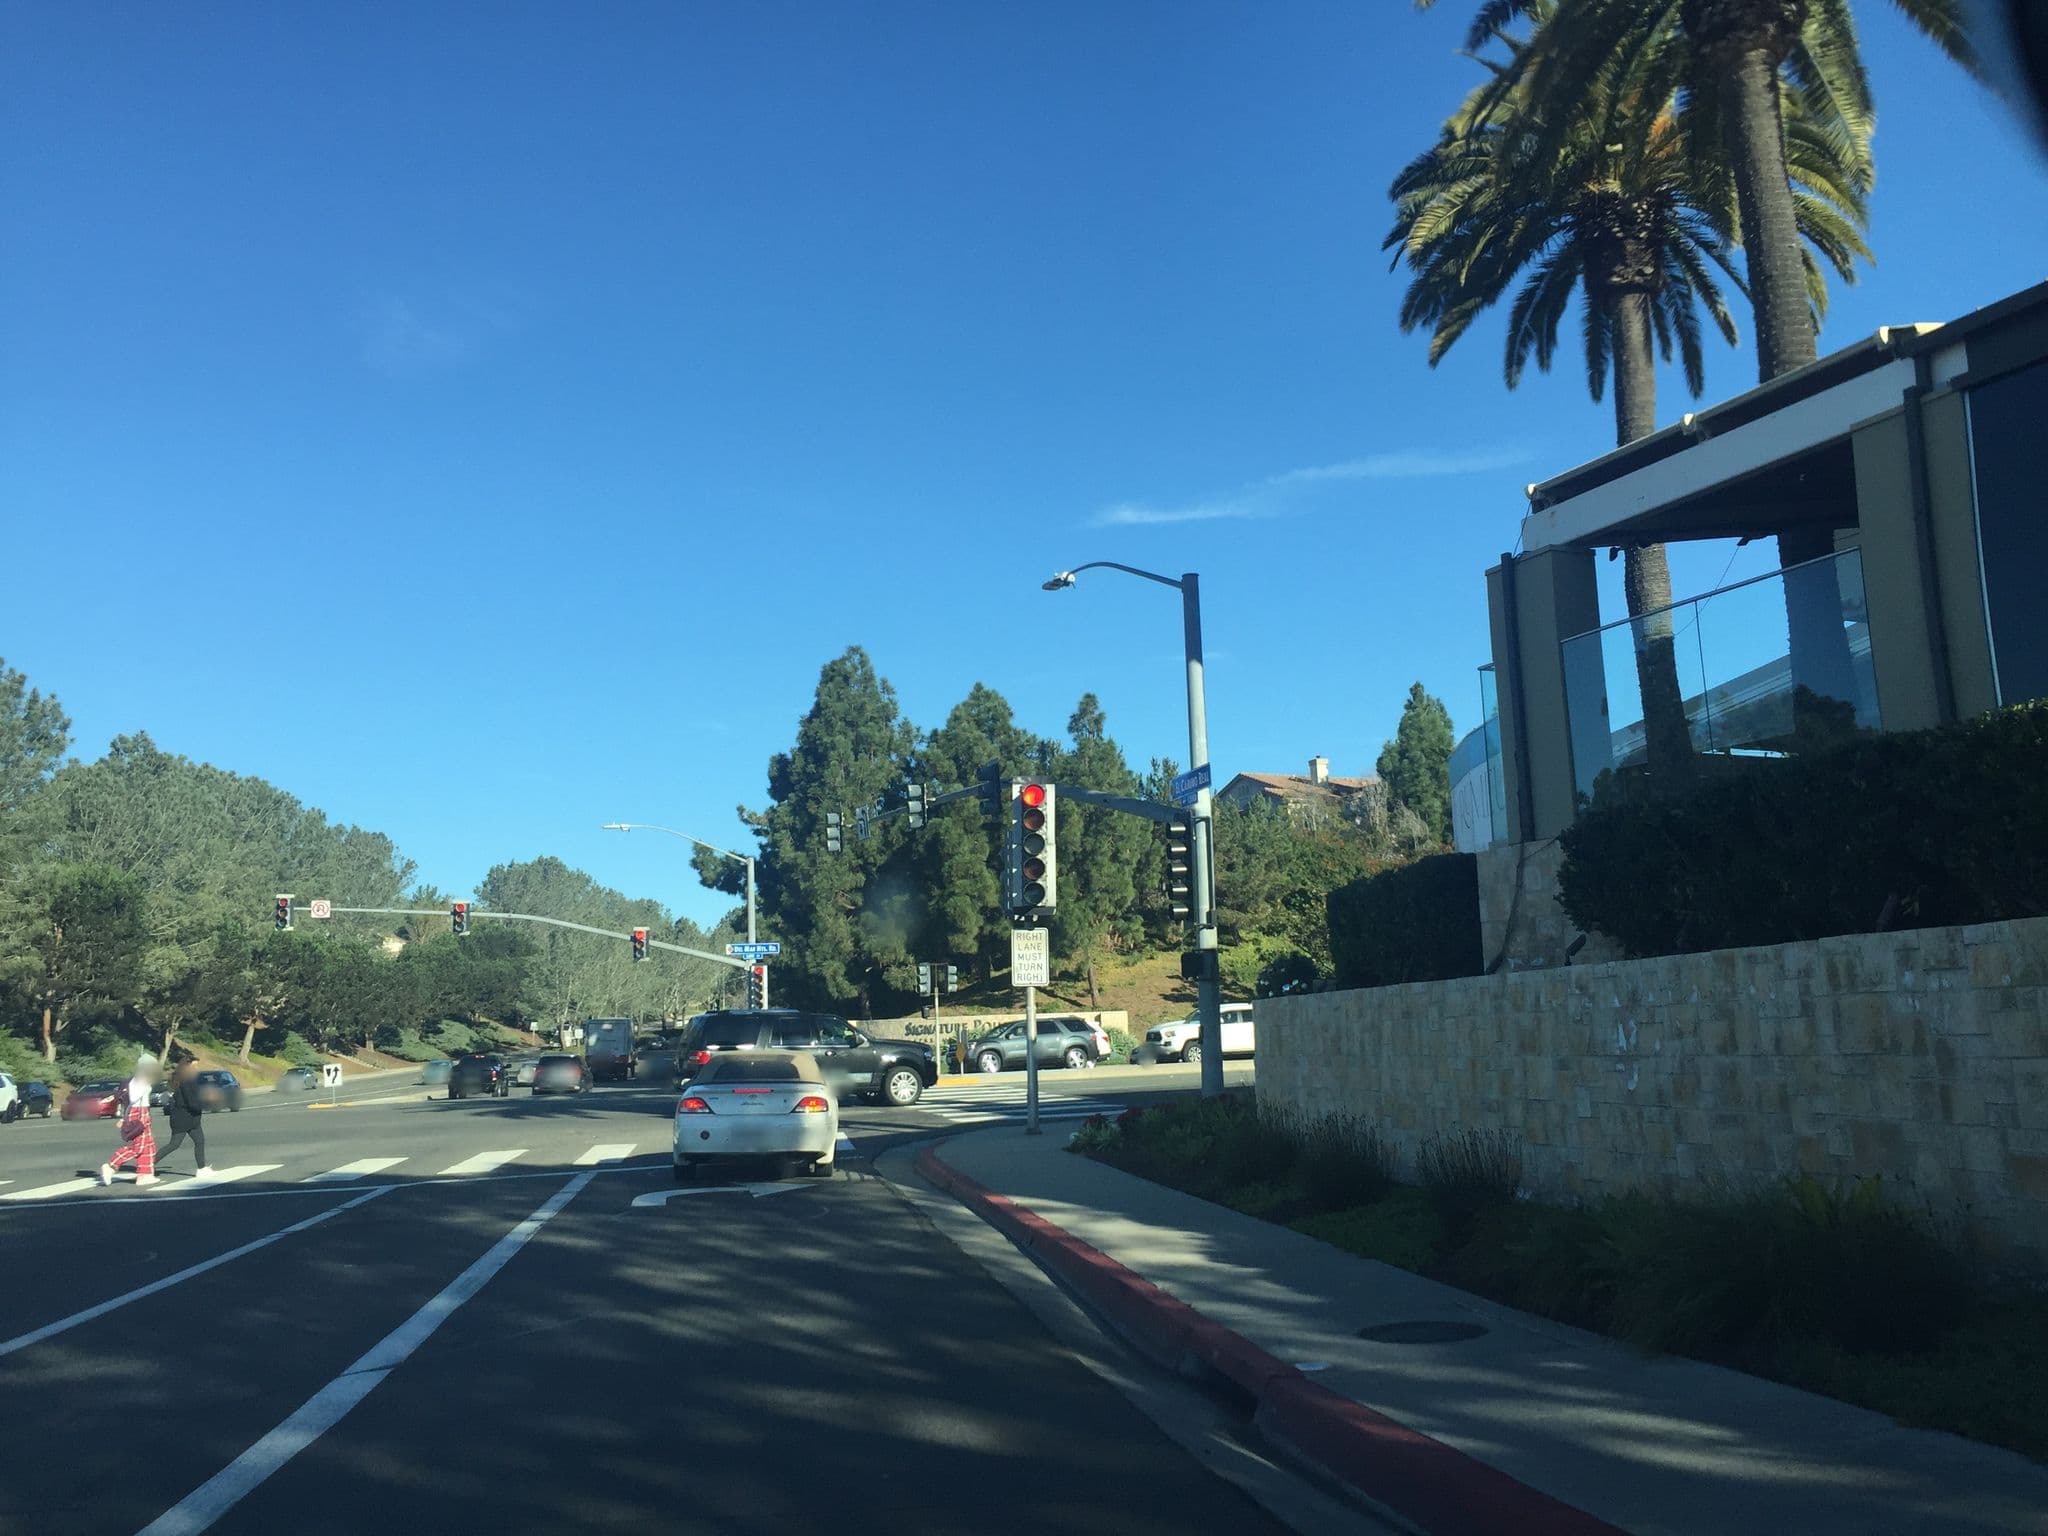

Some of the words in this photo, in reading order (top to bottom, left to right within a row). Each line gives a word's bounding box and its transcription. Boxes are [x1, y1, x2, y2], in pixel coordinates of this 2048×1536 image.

[1016, 932, 1043, 941] RIGHT
[1017, 942, 1042, 951] LANE
[1017, 952, 1042, 961] MUST
[1017, 962, 1043, 971] TURN
[1016, 973, 1043, 982] RIGHT
